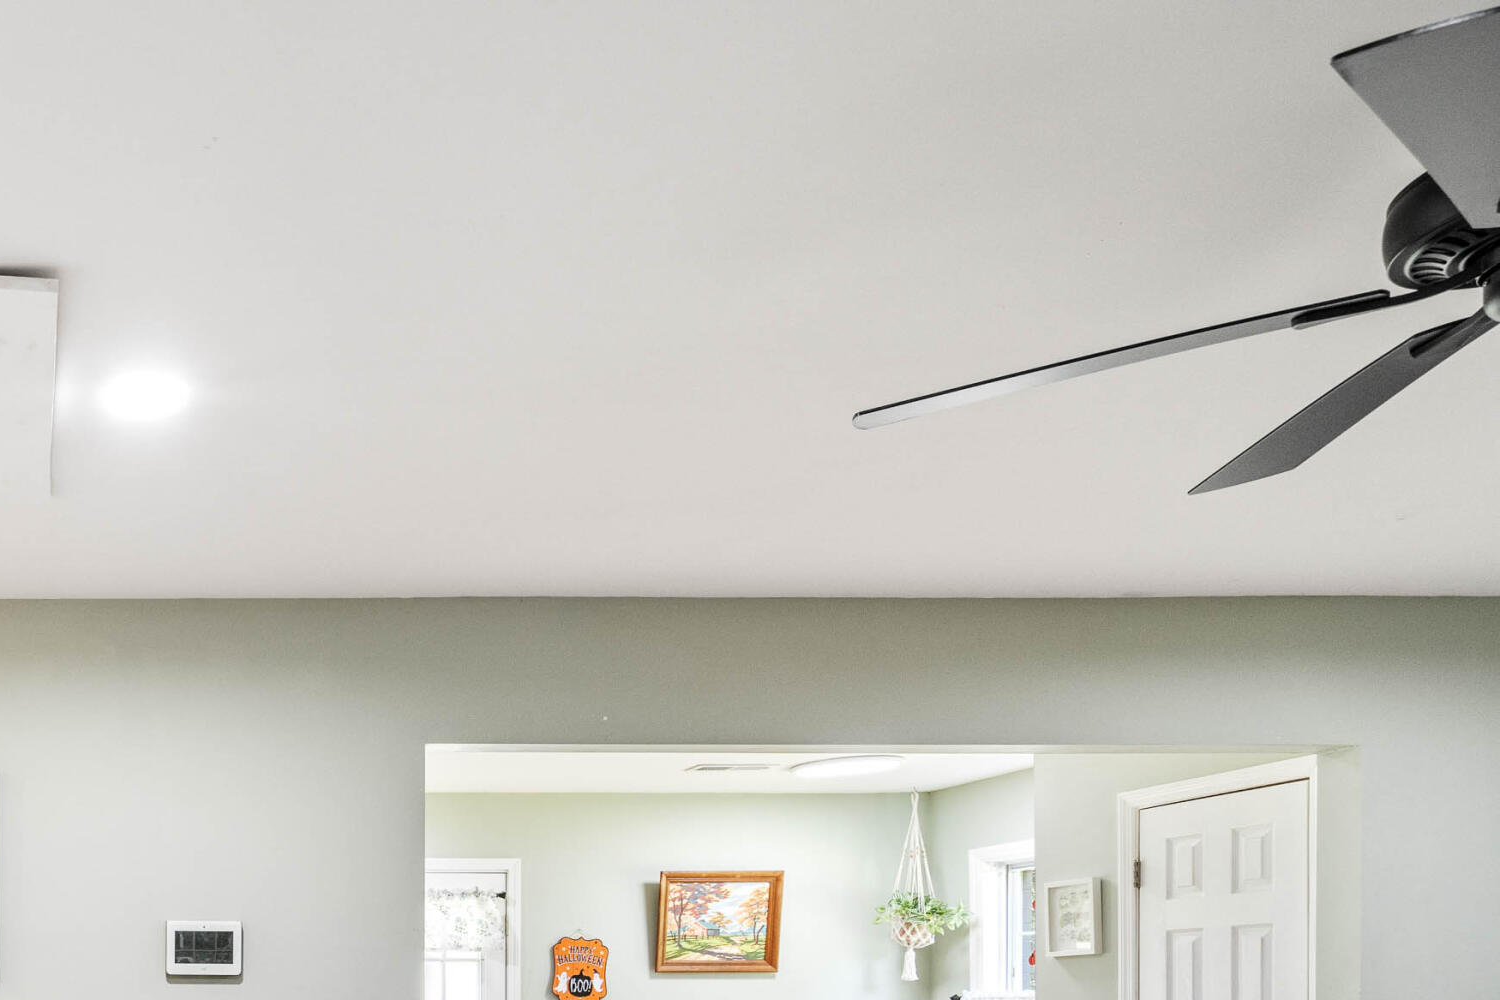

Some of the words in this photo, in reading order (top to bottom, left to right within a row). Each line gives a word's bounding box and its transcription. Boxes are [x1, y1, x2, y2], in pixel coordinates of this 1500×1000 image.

[569, 945, 593, 954] HAPPY
[557, 954, 603, 967] HALLOWEEN
[570, 977, 592, 993] BOO!
